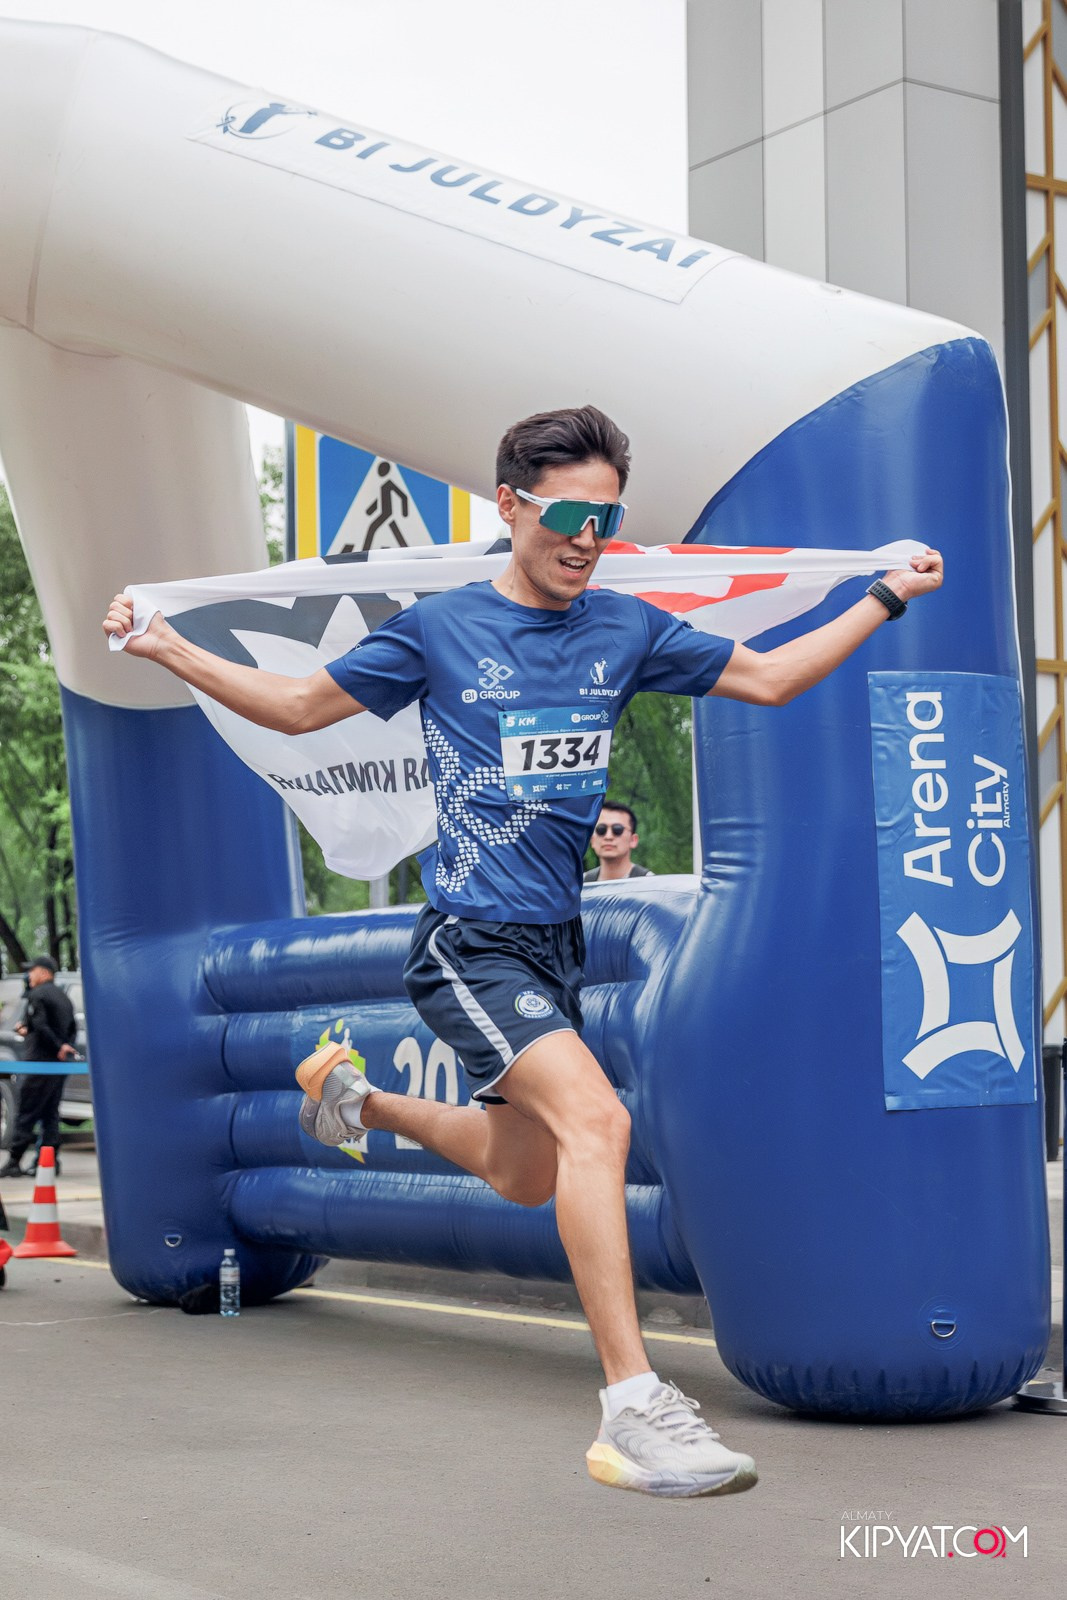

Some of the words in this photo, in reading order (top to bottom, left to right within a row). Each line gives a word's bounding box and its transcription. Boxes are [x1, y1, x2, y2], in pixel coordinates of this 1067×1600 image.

[314, 127, 391, 160] BI
[388, 157, 711, 268] JULDYZAI
[479, 690, 521, 700] GROUP
[506, 716, 516, 727] 5
[518, 717, 537, 726] KM
[521, 734, 602, 771] 1334
[903, 691, 954, 888] Arena
[1002, 781, 1011, 829] Almaty
[967, 754, 1008, 887] City
